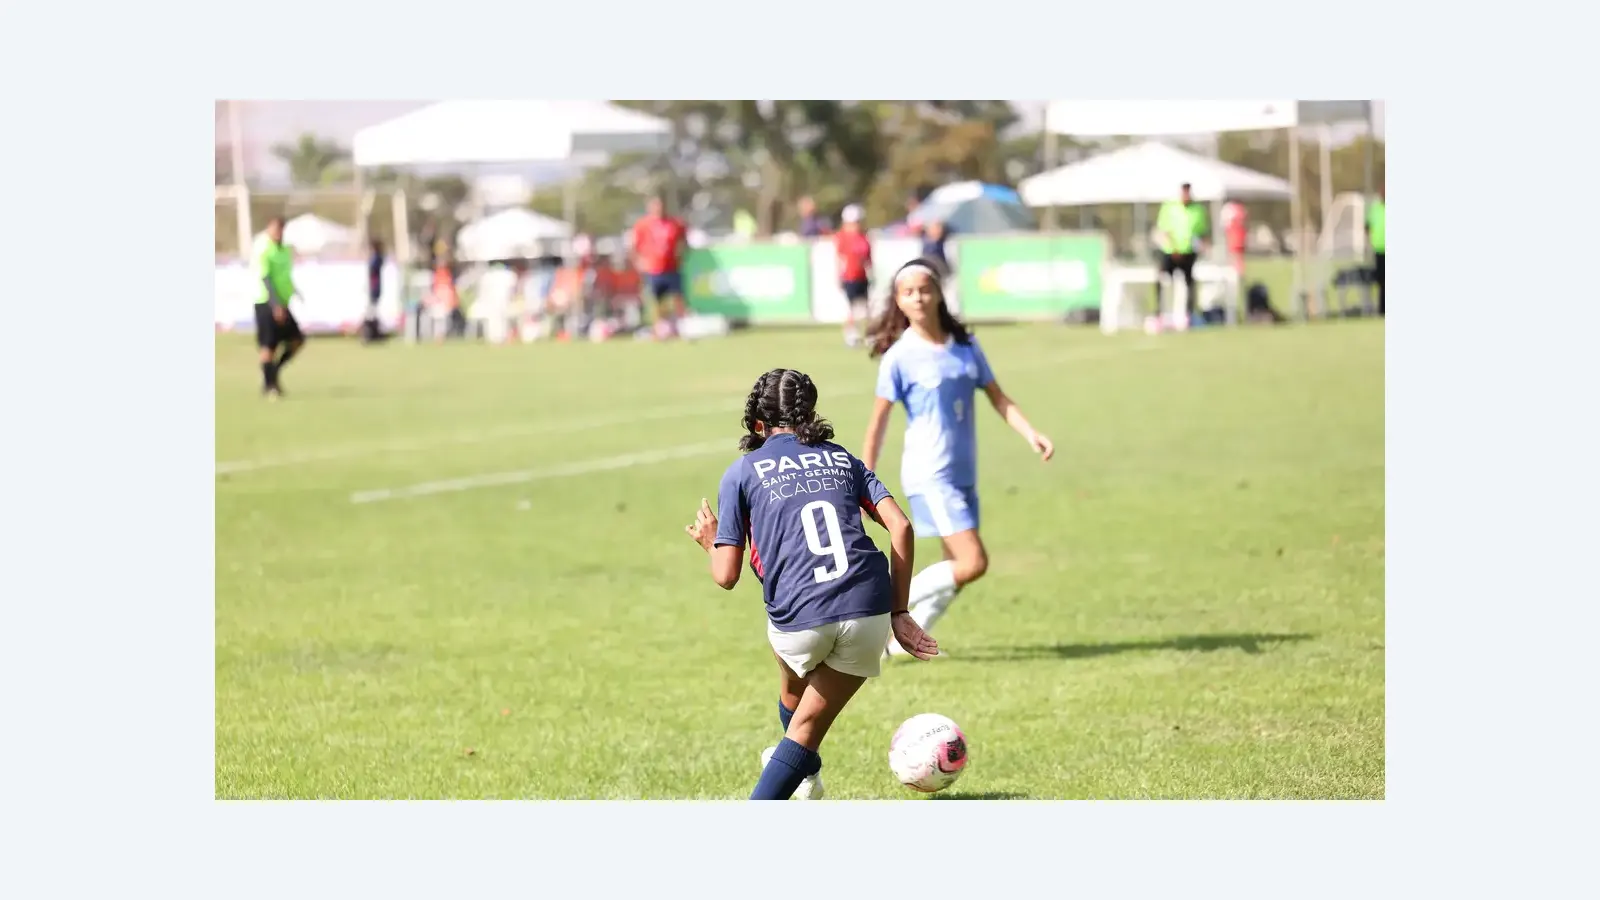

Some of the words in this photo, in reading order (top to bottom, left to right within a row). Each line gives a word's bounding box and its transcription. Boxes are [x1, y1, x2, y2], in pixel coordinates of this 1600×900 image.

[753, 450, 852, 479] PARIS
[762, 468, 854, 489] SAINT-GERMAIN
[769, 477, 854, 504] ACADEMY
[800, 500, 849, 583] 9
